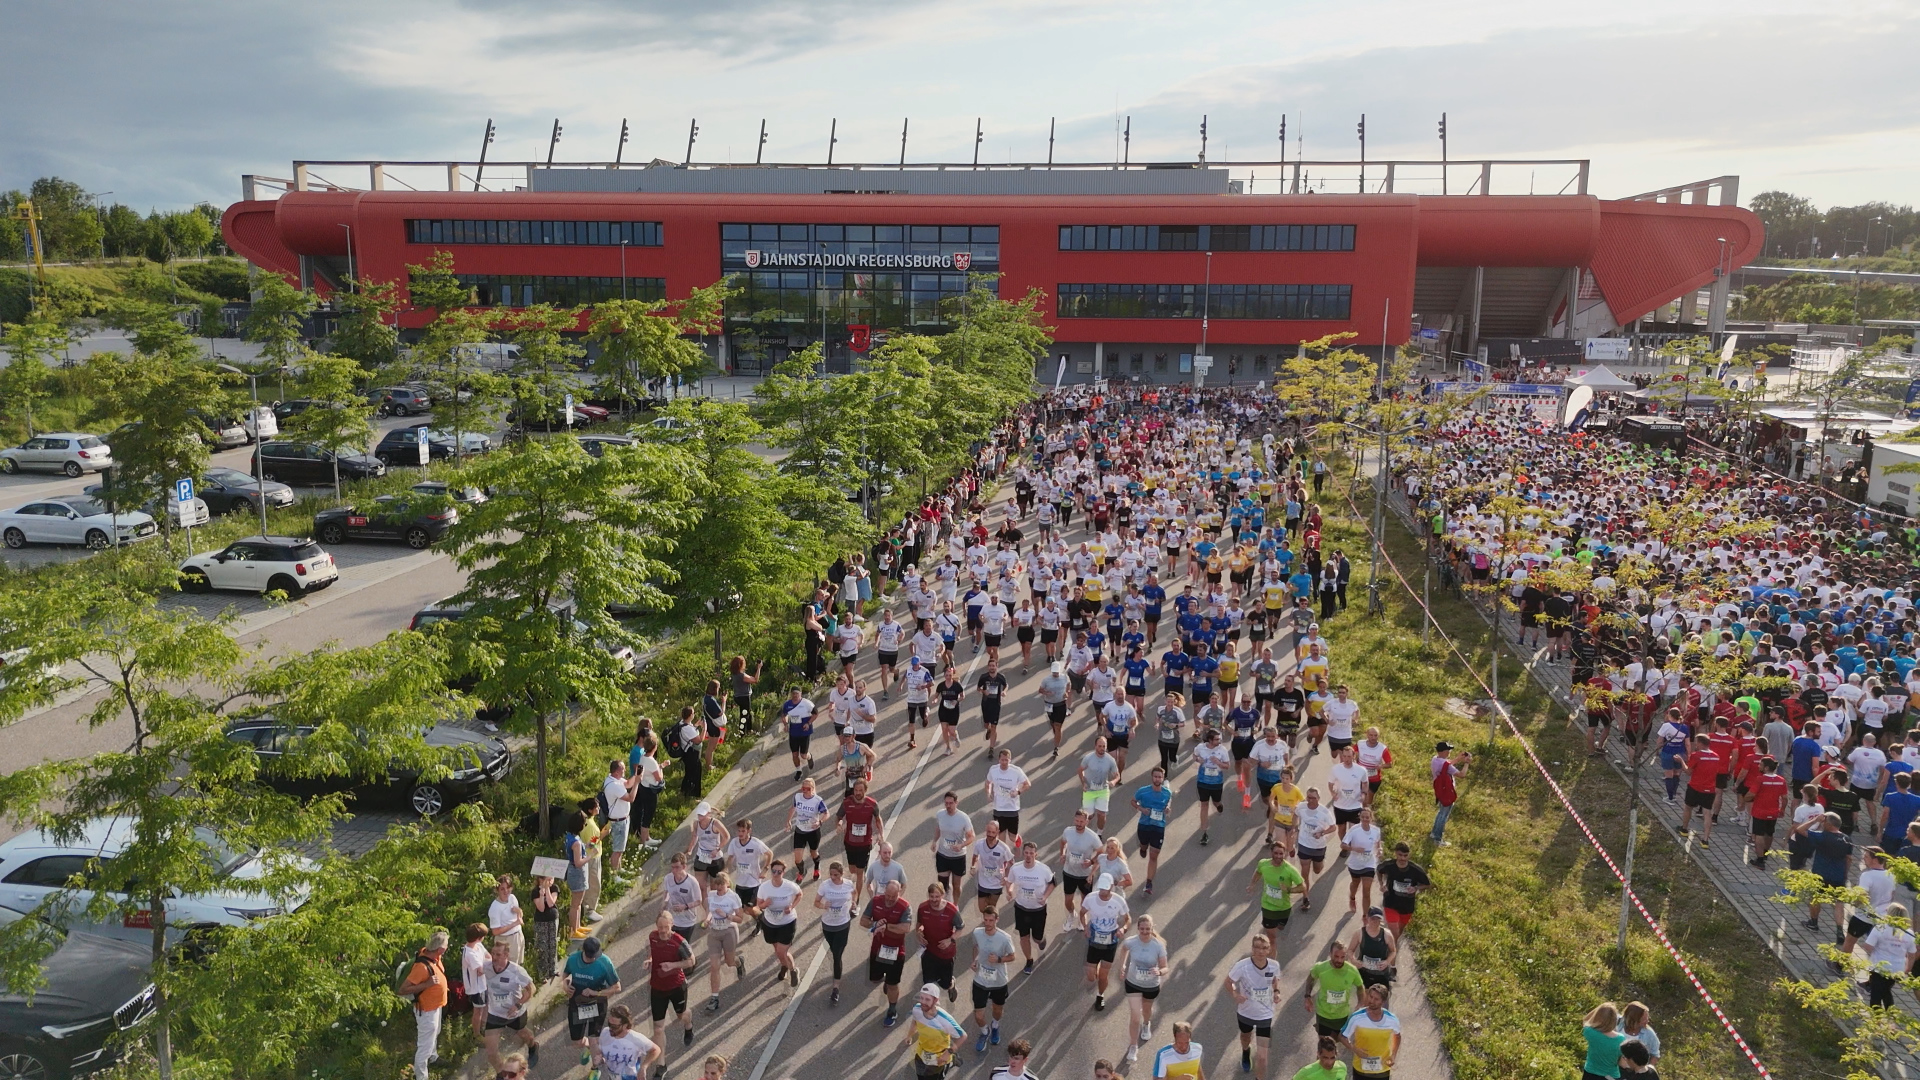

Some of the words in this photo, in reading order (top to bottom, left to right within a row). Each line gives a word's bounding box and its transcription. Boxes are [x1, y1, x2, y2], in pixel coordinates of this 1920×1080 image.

[762, 253, 855, 267] JAHNSTADION
[860, 254, 951, 268] REGENSBURG
[180, 481, 190, 500] P
[574, 972, 594, 981] SIEMENS
